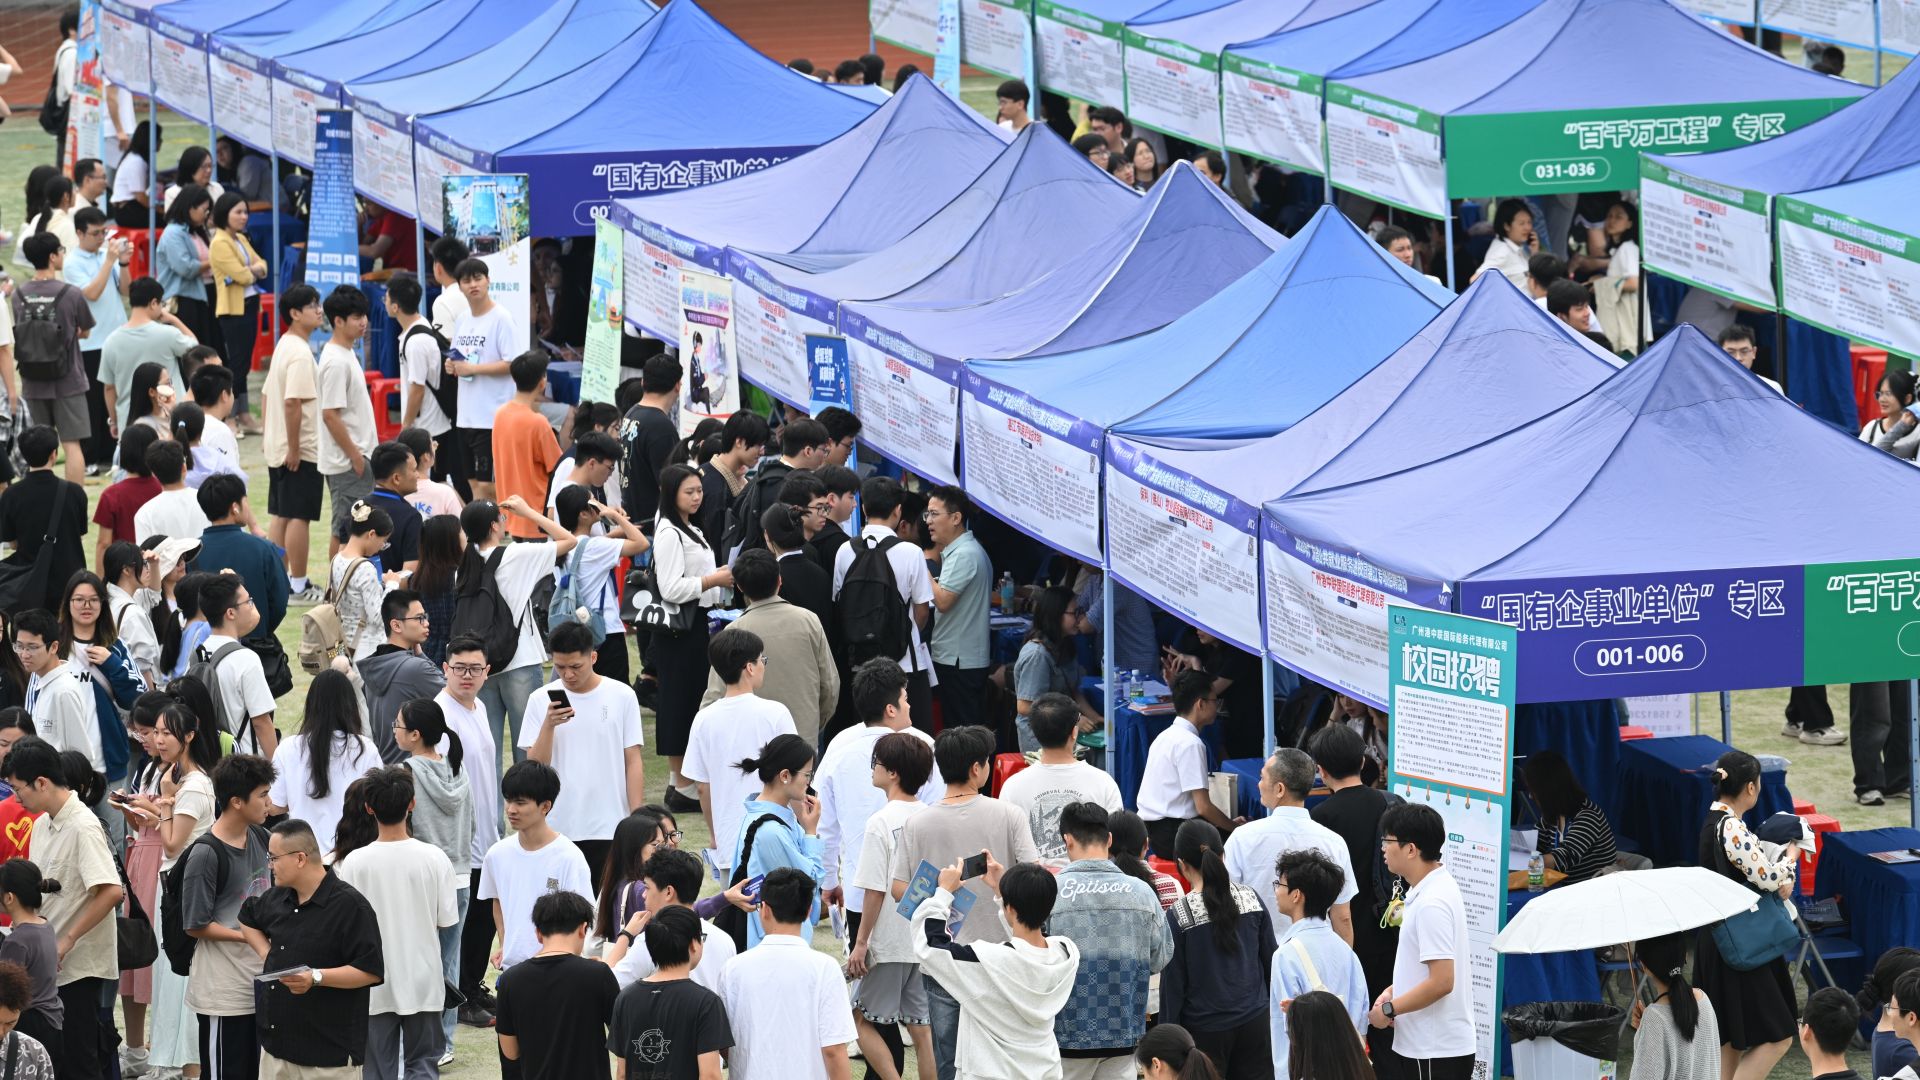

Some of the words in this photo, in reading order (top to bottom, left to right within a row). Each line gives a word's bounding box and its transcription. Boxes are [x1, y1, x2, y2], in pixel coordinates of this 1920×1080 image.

[1564, 116, 1722, 150] “百千万工程”
[1733, 113, 1786, 140] 专区
[1535, 162, 1596, 180] 031-036
[590, 206, 611, 219] 00
[1481, 583, 1715, 631] “国有企事业单位”
[1728, 580, 1785, 620] 专区
[1411, 625, 1508, 652] 广州港中联国际船务代理有限公司
[1596, 643, 1684, 668] 001-006
[1402, 641, 1501, 698] 校园招聘
[1060, 878, 1132, 904] Eptison
